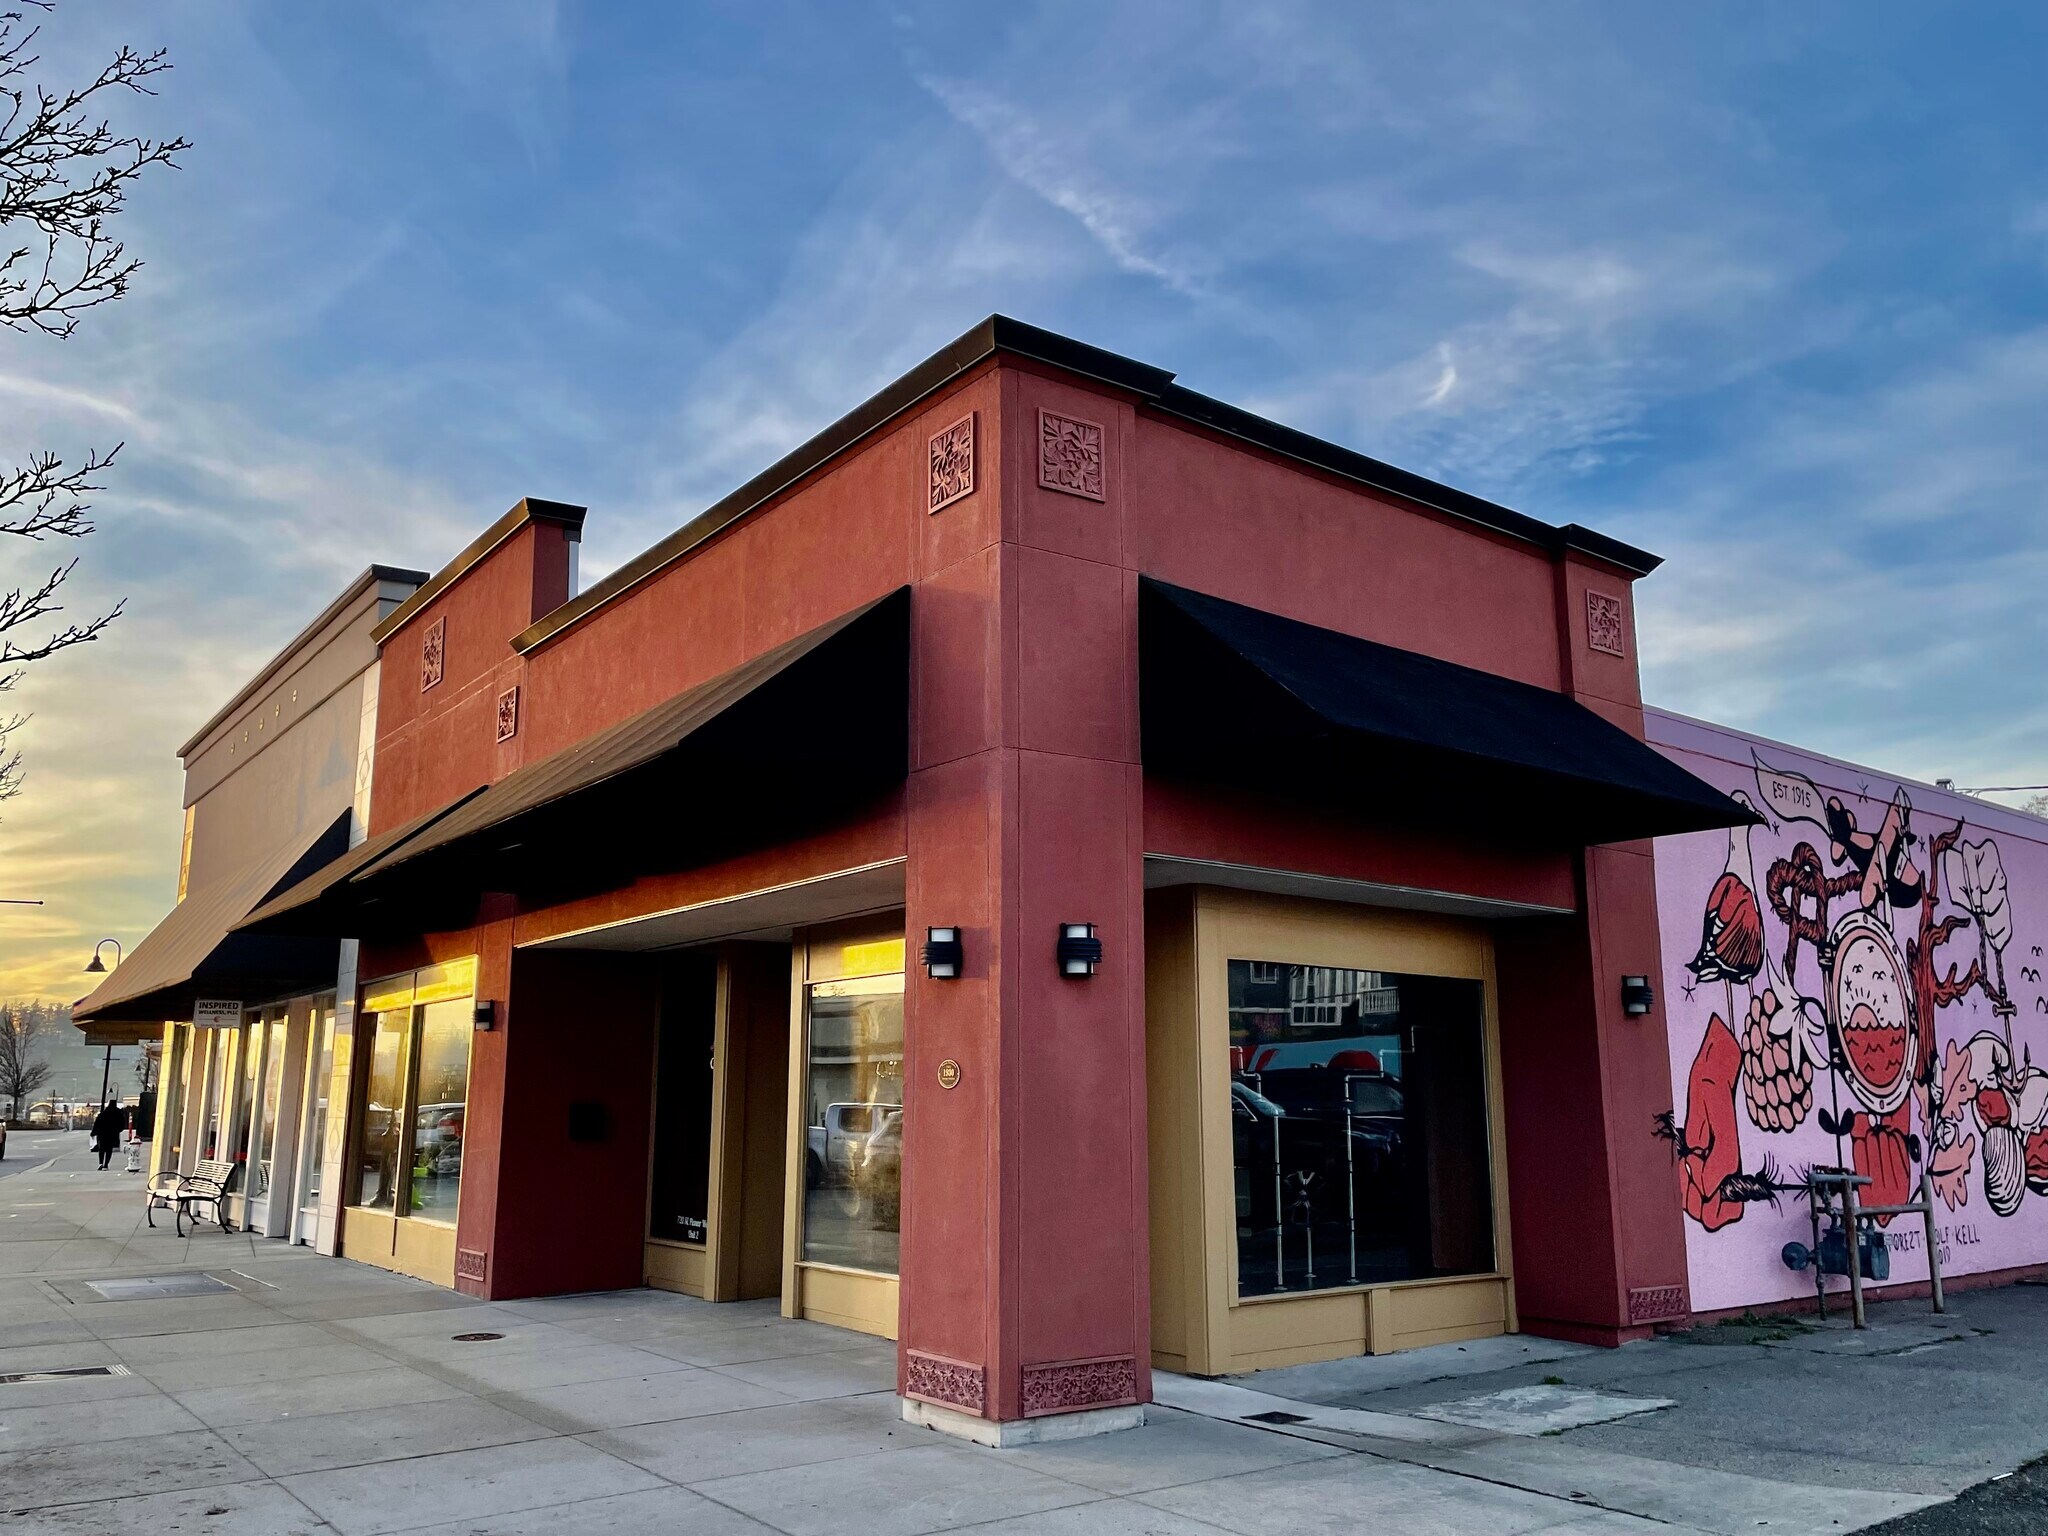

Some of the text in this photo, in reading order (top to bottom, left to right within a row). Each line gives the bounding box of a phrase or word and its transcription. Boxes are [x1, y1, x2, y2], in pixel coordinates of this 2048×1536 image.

[1772, 780, 1811, 808] EST. 1915
[198, 1001, 239, 1010] INSPIRED
[1935, 1226, 1949, 1246] OLF
[1955, 1224, 1980, 1246] KELL
